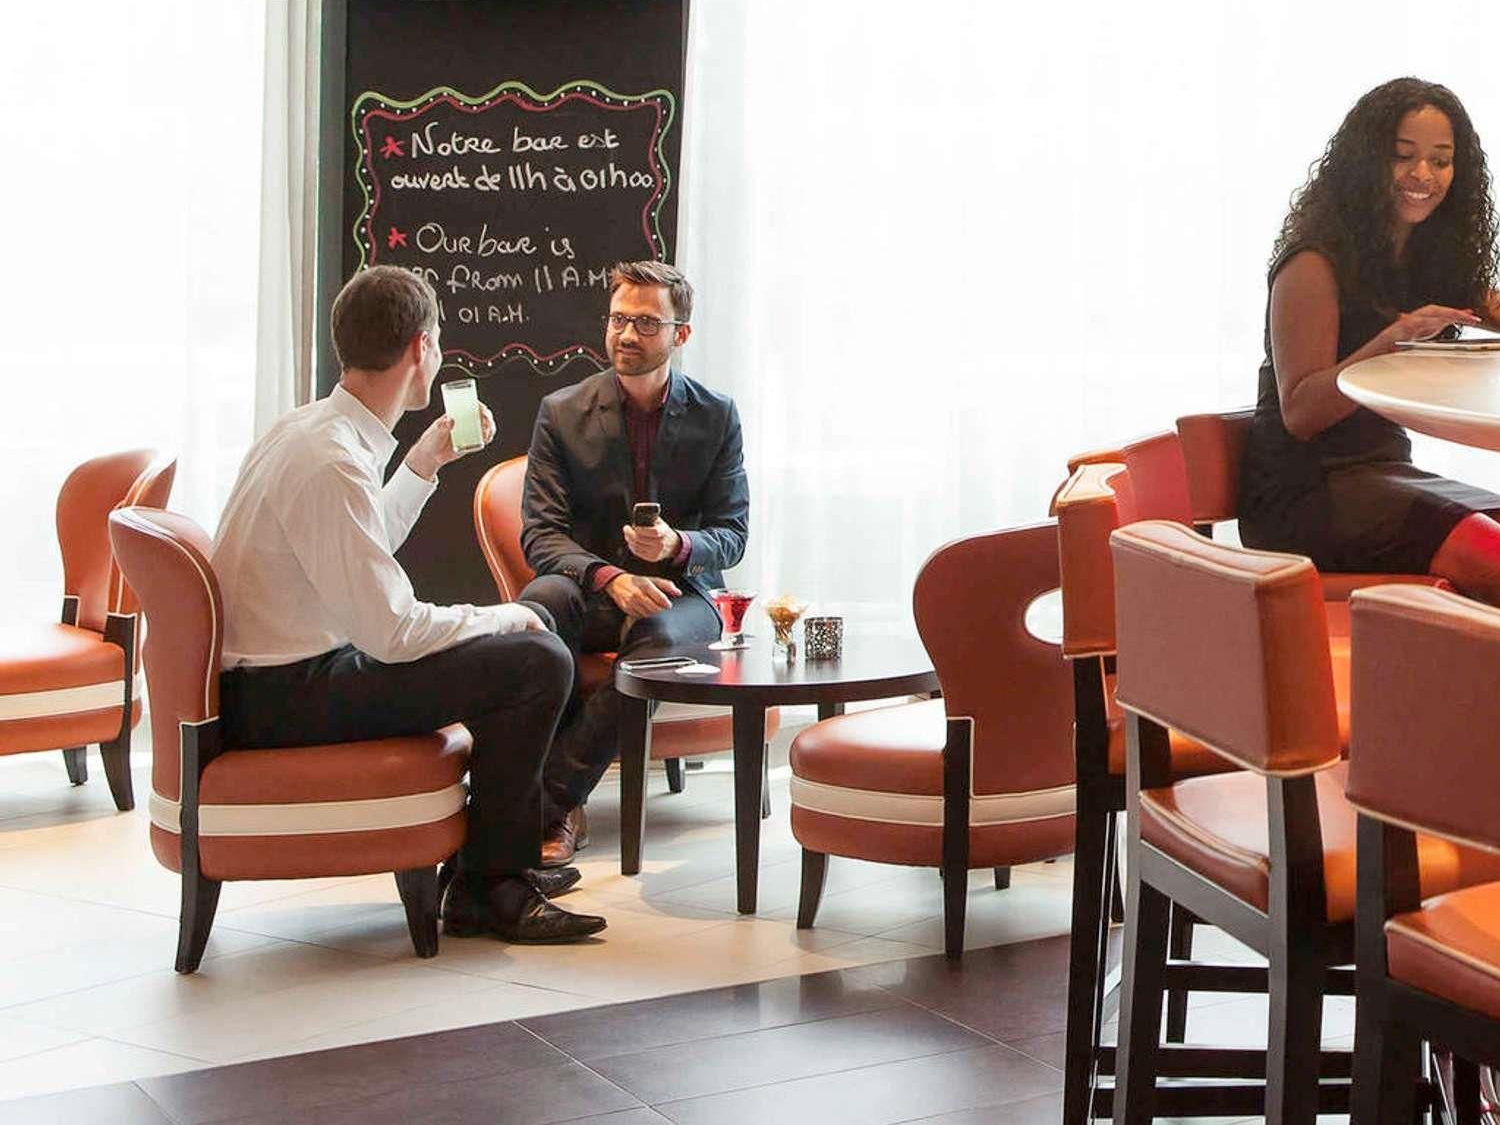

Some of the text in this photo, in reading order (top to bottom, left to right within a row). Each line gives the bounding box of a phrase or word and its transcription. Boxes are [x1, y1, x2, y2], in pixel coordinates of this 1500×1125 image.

[513, 127, 570, 153] bar
[577, 128, 621, 150] est
[390, 167, 471, 191] ouvert
[473, 164, 501, 192] de
[555, 167, 577, 193] à
[544, 226, 576, 260] is
